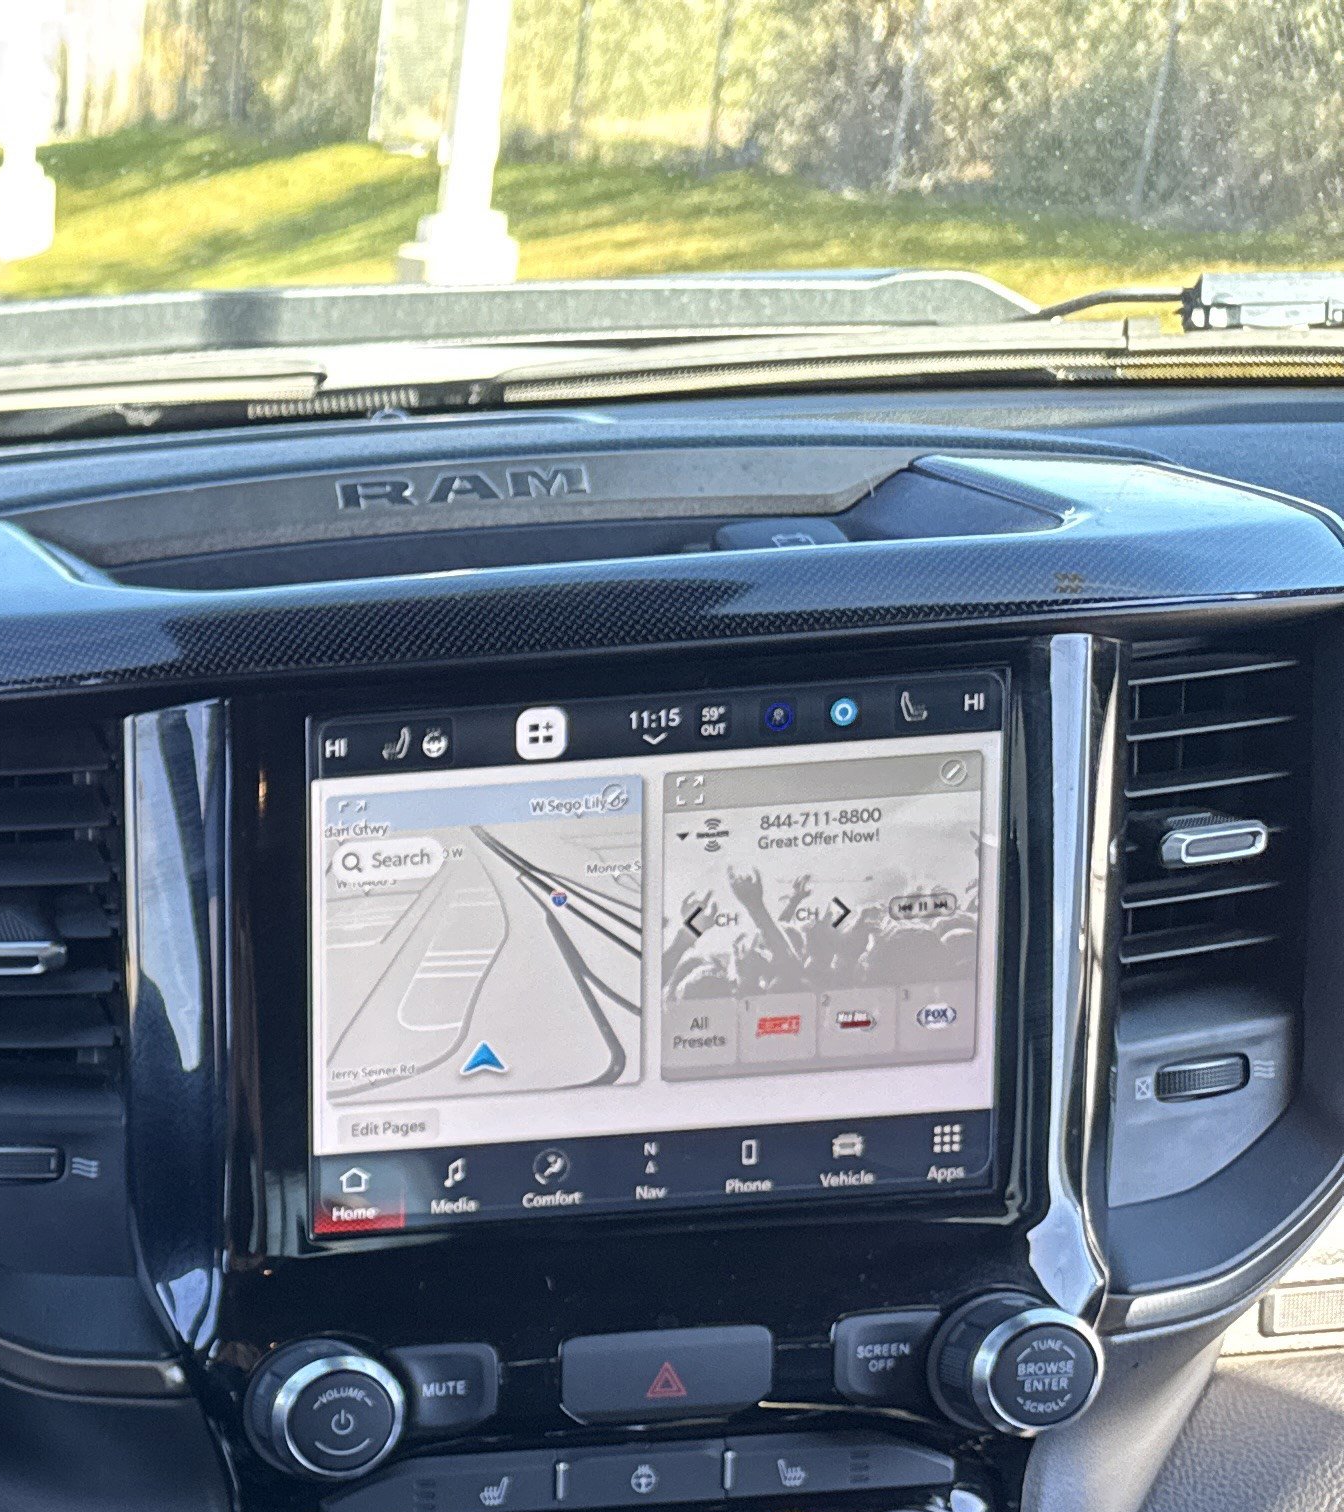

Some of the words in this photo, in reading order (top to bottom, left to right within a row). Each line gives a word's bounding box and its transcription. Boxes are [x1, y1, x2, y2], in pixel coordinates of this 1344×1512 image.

[335, 462, 591, 509] RAM
[964, 693, 985, 711] HI
[629, 707, 682, 731] 11:15
[701, 722, 727, 736] OUT
[325, 738, 349, 758] HI
[531, 801, 545, 812] W
[547, 799, 582, 813] Sego
[584, 795, 607, 811] Lily
[759, 807, 882, 830] 844-711-8800
[757, 835, 799, 851] Great
[801, 831, 839, 847] Offer
[842, 828, 881, 844] Now!
[372, 849, 431, 869] Search
[715, 914, 738, 927] CH
[796, 906, 819, 921] CH
[924, 1008, 948, 1020] FOX
[690, 1016, 708, 1031] All
[673, 1034, 727, 1050] Presets
[351, 1121, 380, 1138] Edit
[382, 1120, 427, 1138] Pages
[643, 1142, 658, 1156] N
[820, 1170, 875, 1187] Vehicle
[926, 1165, 966, 1183] Apps
[635, 1186, 666, 1200] Nav
[725, 1179, 772, 1195] Phone
[430, 1199, 479, 1215] Media
[522, 1191, 584, 1209] Comfort
[332, 1206, 377, 1222] Home
[856, 1343, 911, 1359] SCREEN
[1031, 1339, 1063, 1352] TUNE
[868, 1358, 896, 1373] OFF
[1017, 1360, 1074, 1376] BROWSE
[422, 1380, 467, 1398] MUTE
[1024, 1378, 1069, 1393] ENTER
[318, 1387, 365, 1404] VOLUME
[1022, 1400, 1067, 1414] SCROLL
